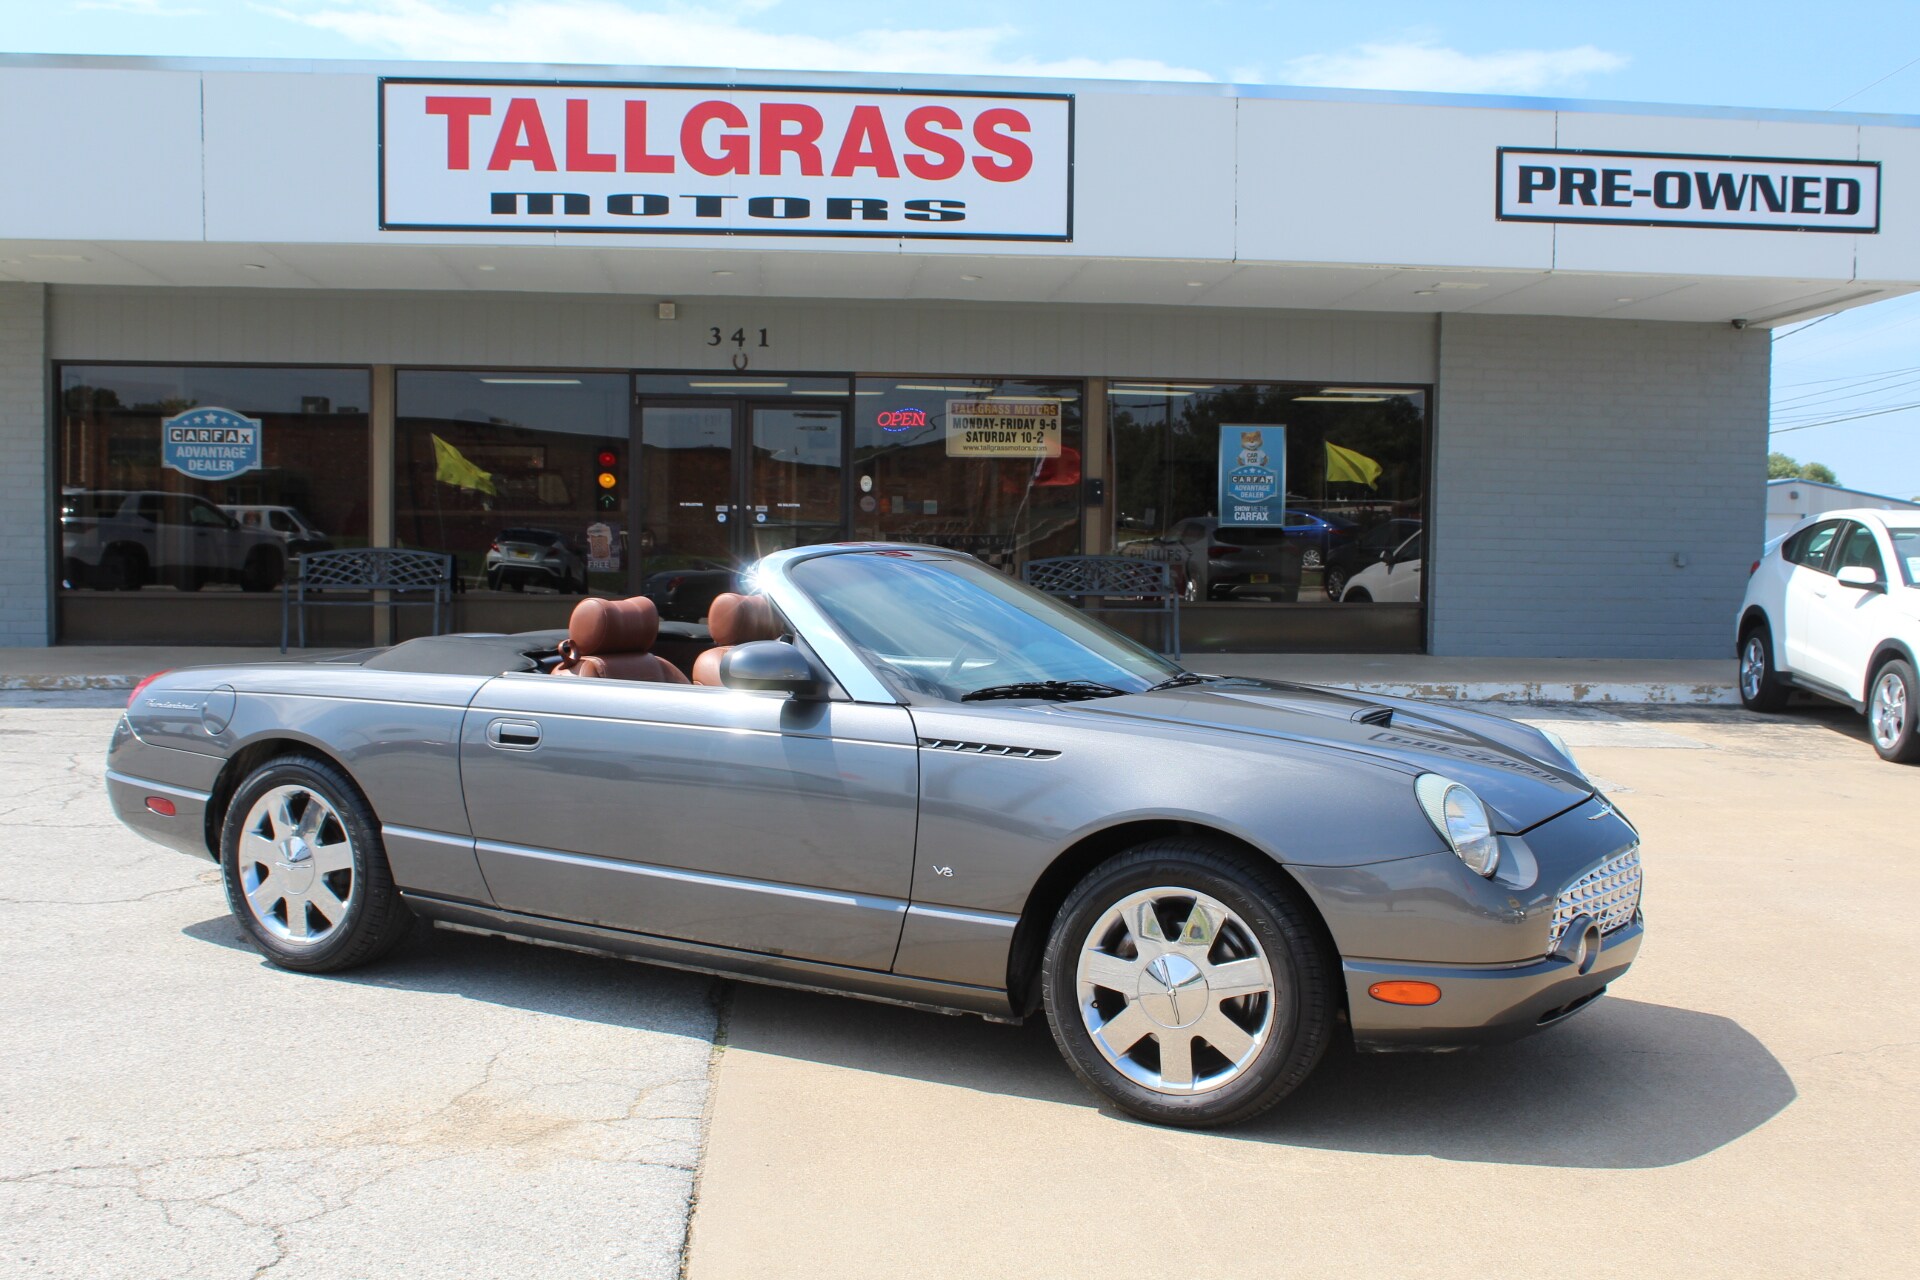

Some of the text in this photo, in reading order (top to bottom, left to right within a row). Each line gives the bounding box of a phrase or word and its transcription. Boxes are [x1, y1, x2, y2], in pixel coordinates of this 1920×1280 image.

[424, 95, 1034, 183] TALLGRASS
[1517, 164, 1861, 216] PRE-OWNED
[953, 403, 1058, 416] TALLGRASS MOTORS
[876, 410, 928, 428] OPEN
[952, 417, 1057, 431] MONDAY-FRIDAY 9-6
[171, 429, 251, 444] CARFAX
[965, 430, 1045, 444] SATURDAY 10-2
[175, 445, 247, 459] ADVANTAGE
[962, 444, 1048, 453] www.tallgrassmotors.com
[188, 459, 235, 472] DEALER
[1231, 476, 1274, 485] CARFAX
[1234, 484, 1271, 492] ADVANTAGE
[1240, 491, 1265, 499] DEALER
[1233, 511, 1270, 521] CARFAX
[932, 865, 954, 877] V8
